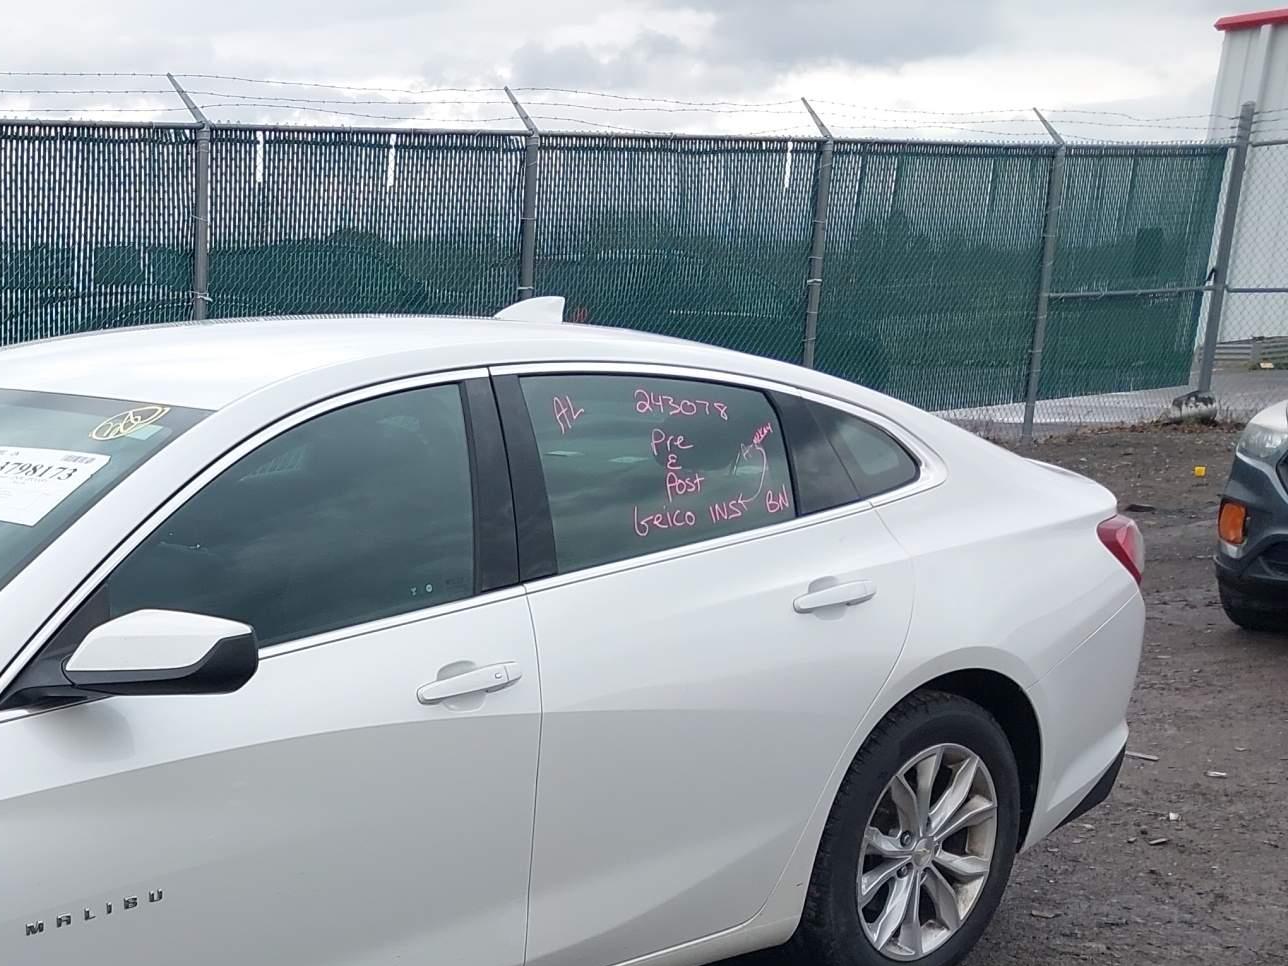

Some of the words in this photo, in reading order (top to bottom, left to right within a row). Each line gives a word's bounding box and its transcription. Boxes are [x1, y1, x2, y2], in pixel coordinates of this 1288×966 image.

[634, 389, 728, 421] 243078
[650, 428, 694, 456] Pre
[25, 888, 163, 936] MALIBU
